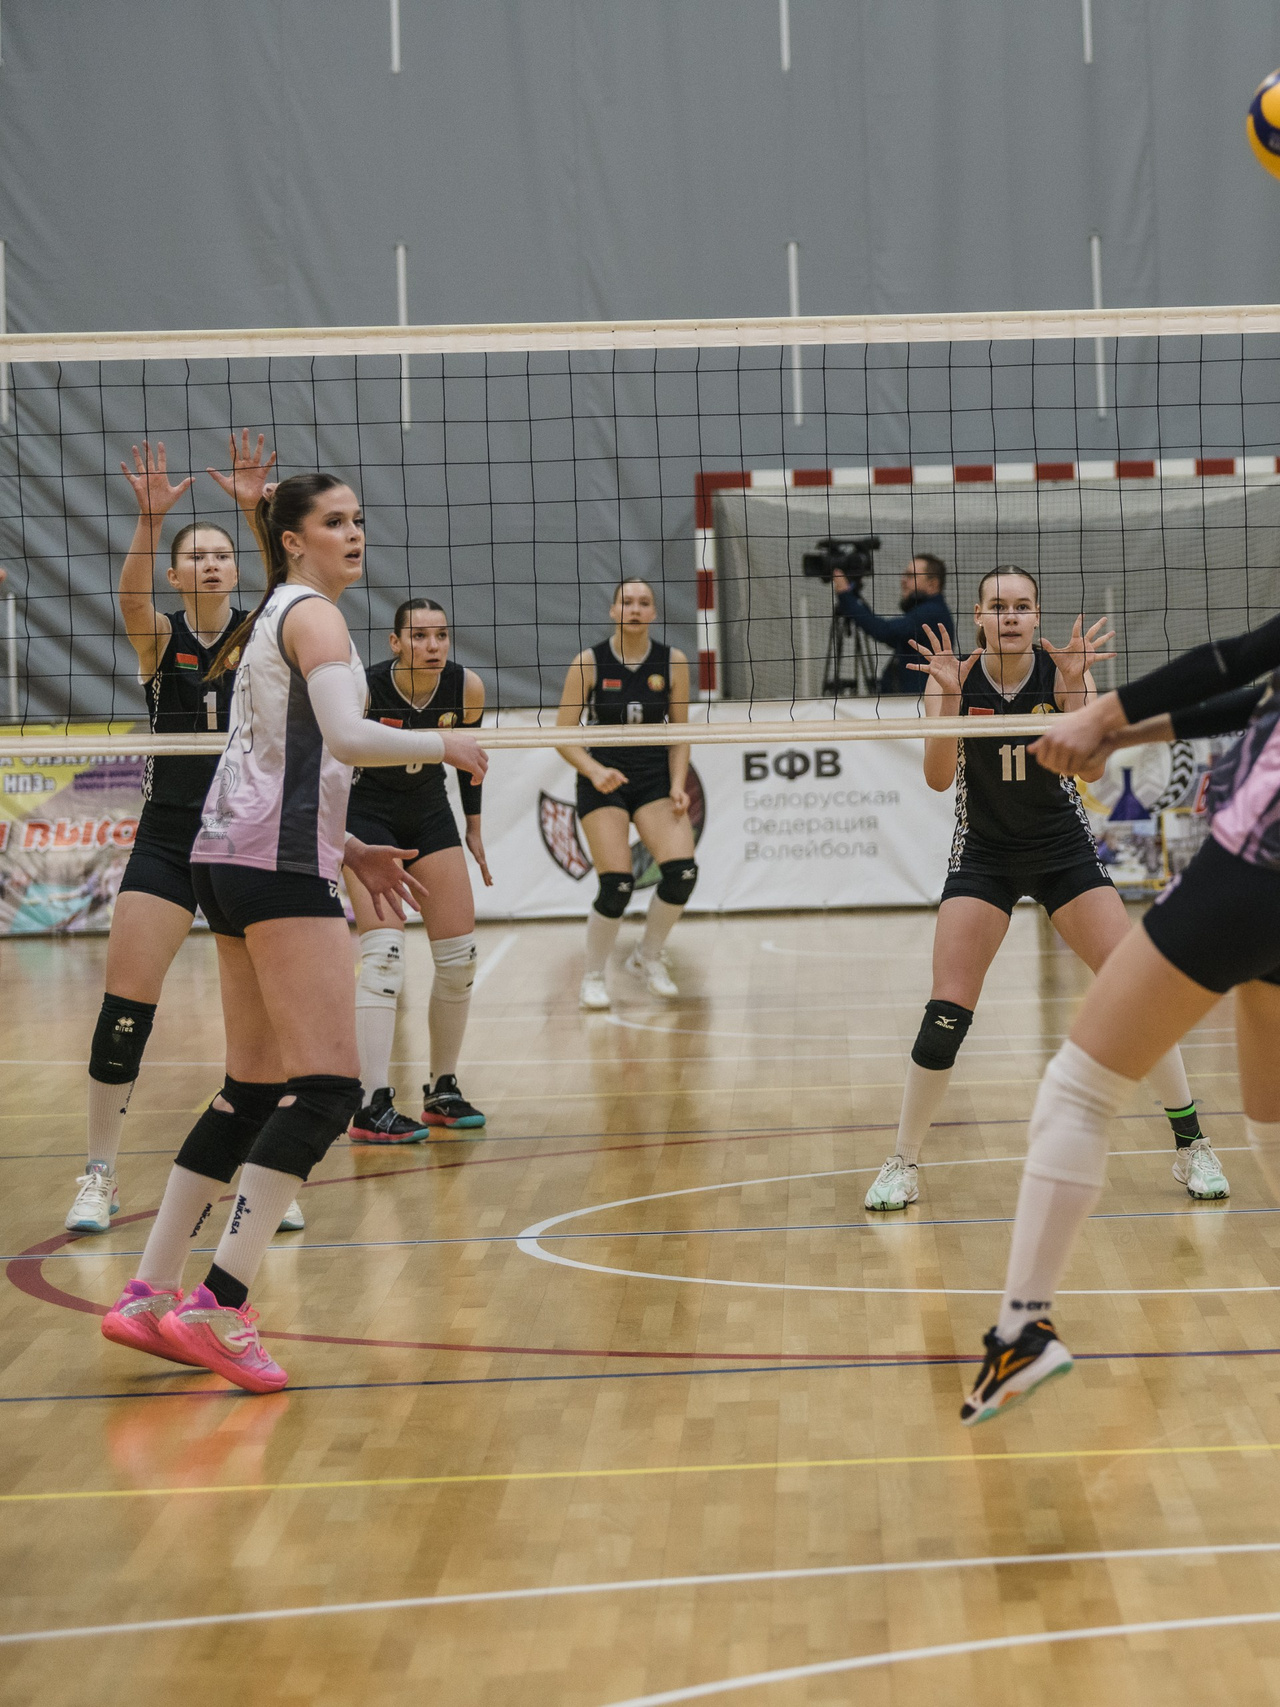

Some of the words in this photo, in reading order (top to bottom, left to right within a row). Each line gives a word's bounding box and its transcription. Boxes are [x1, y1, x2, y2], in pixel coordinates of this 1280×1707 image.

[203, 691, 218, 730] 1
[743, 748, 842, 782] БФВ
[999, 744, 1027, 781] 11
[743, 790, 901, 810] Белорусская
[22, 816, 140, 853] высо
[743, 815, 879, 835] Федерация
[744, 839, 879, 862] Волейбола
[230, 1194, 247, 1235] MIKASA
